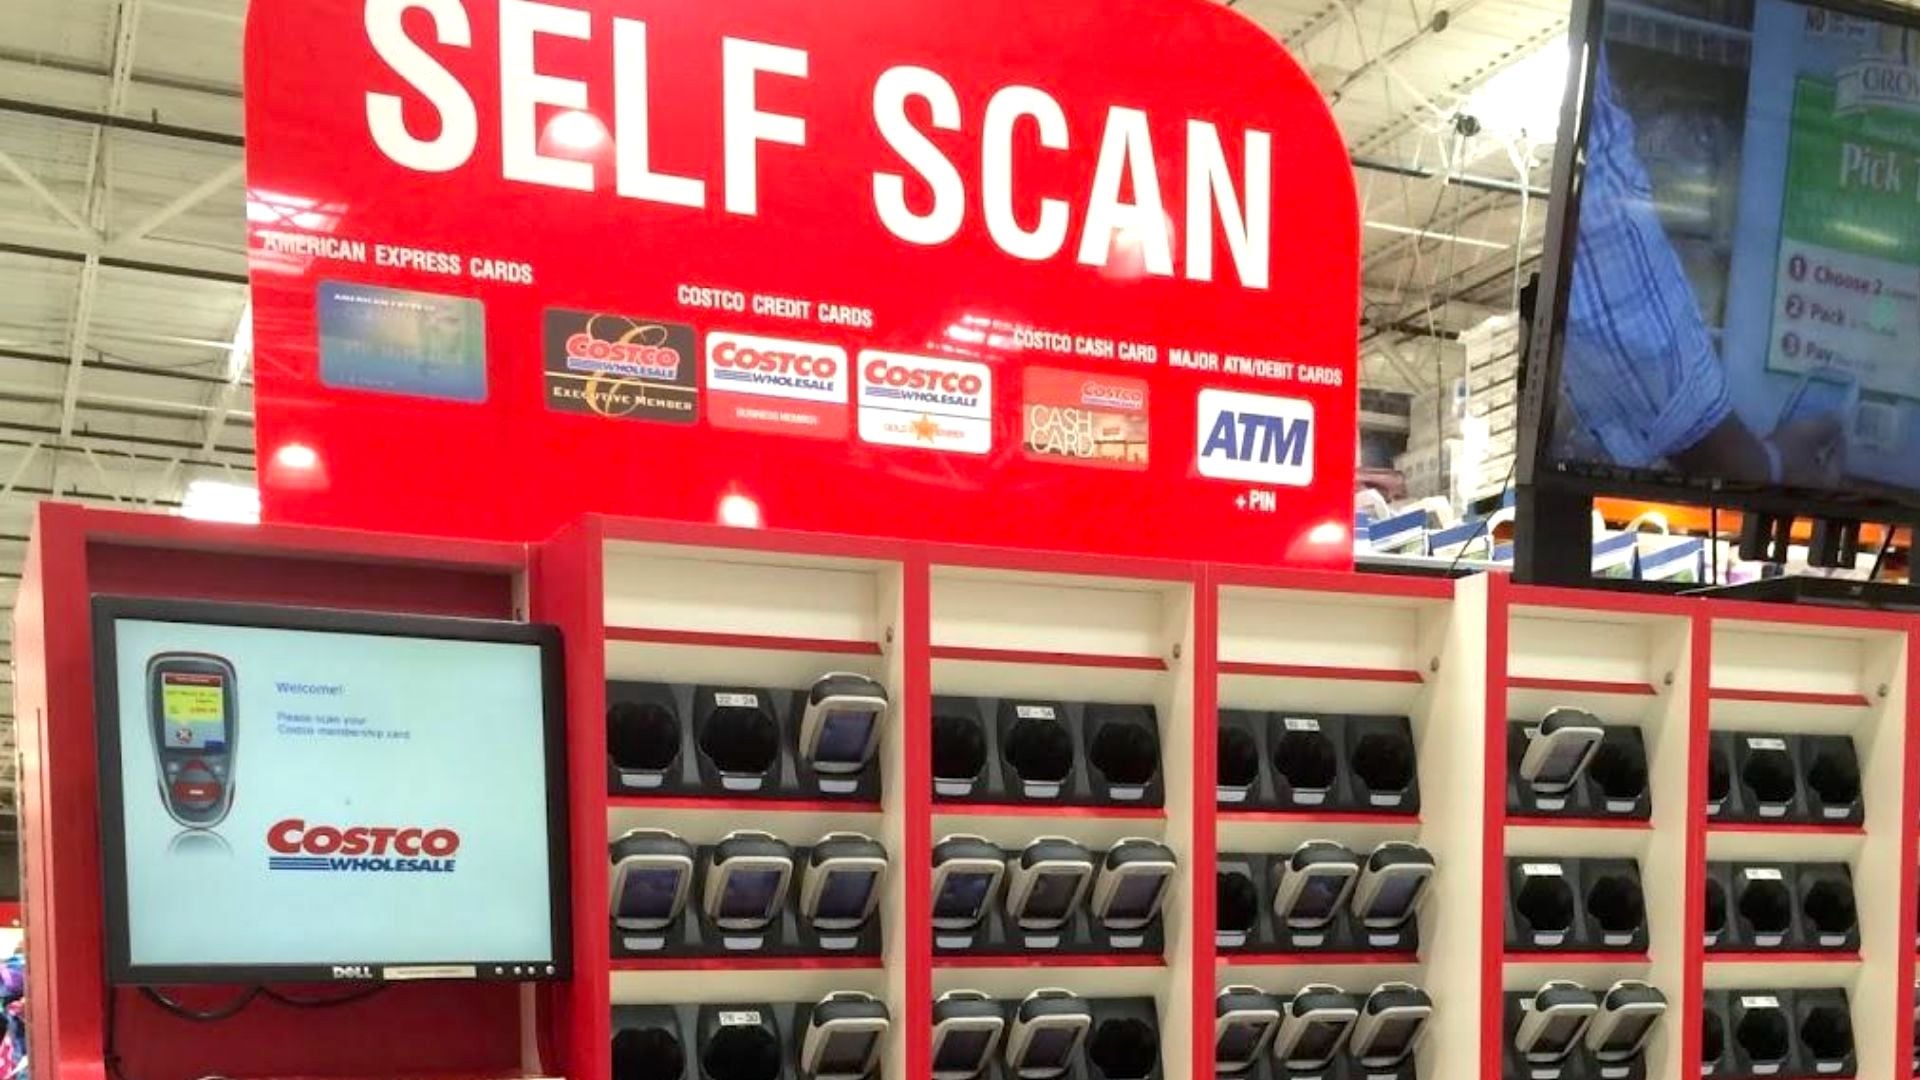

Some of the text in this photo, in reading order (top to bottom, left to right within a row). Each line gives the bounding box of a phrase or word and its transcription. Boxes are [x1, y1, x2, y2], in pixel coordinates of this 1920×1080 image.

[365, 0, 1271, 289] SELF SCAN
[1840, 142, 1900, 193] Pick
[263, 231, 533, 284] AMERICAN EXPRESS CARDS
[1814, 266, 1870, 294] Choose
[678, 285, 873, 328] COSTCO CREDIT CARDS
[567, 335, 679, 366] COSTCO
[712, 341, 837, 378] COSTCO
[1013, 329, 1156, 363] COSTCO CASH CARD
[601, 361, 676, 379] WHOLESALE
[751, 372, 834, 391] WHOLESALE
[864, 359, 982, 396] COSTCO
[1169, 348, 1342, 386] MAJOR ATM/DEBIT CARDS
[553, 386, 692, 411] EXECUTIVE MEMBER
[900, 390, 978, 408] WHOLESALE
[1030, 405, 1092, 431] CASH
[1030, 428, 1094, 458] CARD
[1201, 410, 1309, 466] ATM
[1249, 489, 1276, 512] PIN
[276, 682, 344, 696] Welcome!
[277, 712, 366, 728] Please scan your
[278, 724, 411, 740] Costco membership card
[267, 819, 460, 857] COSTCO
[329, 857, 457, 872] WHOLESALE
[333, 966, 373, 979] DELL
